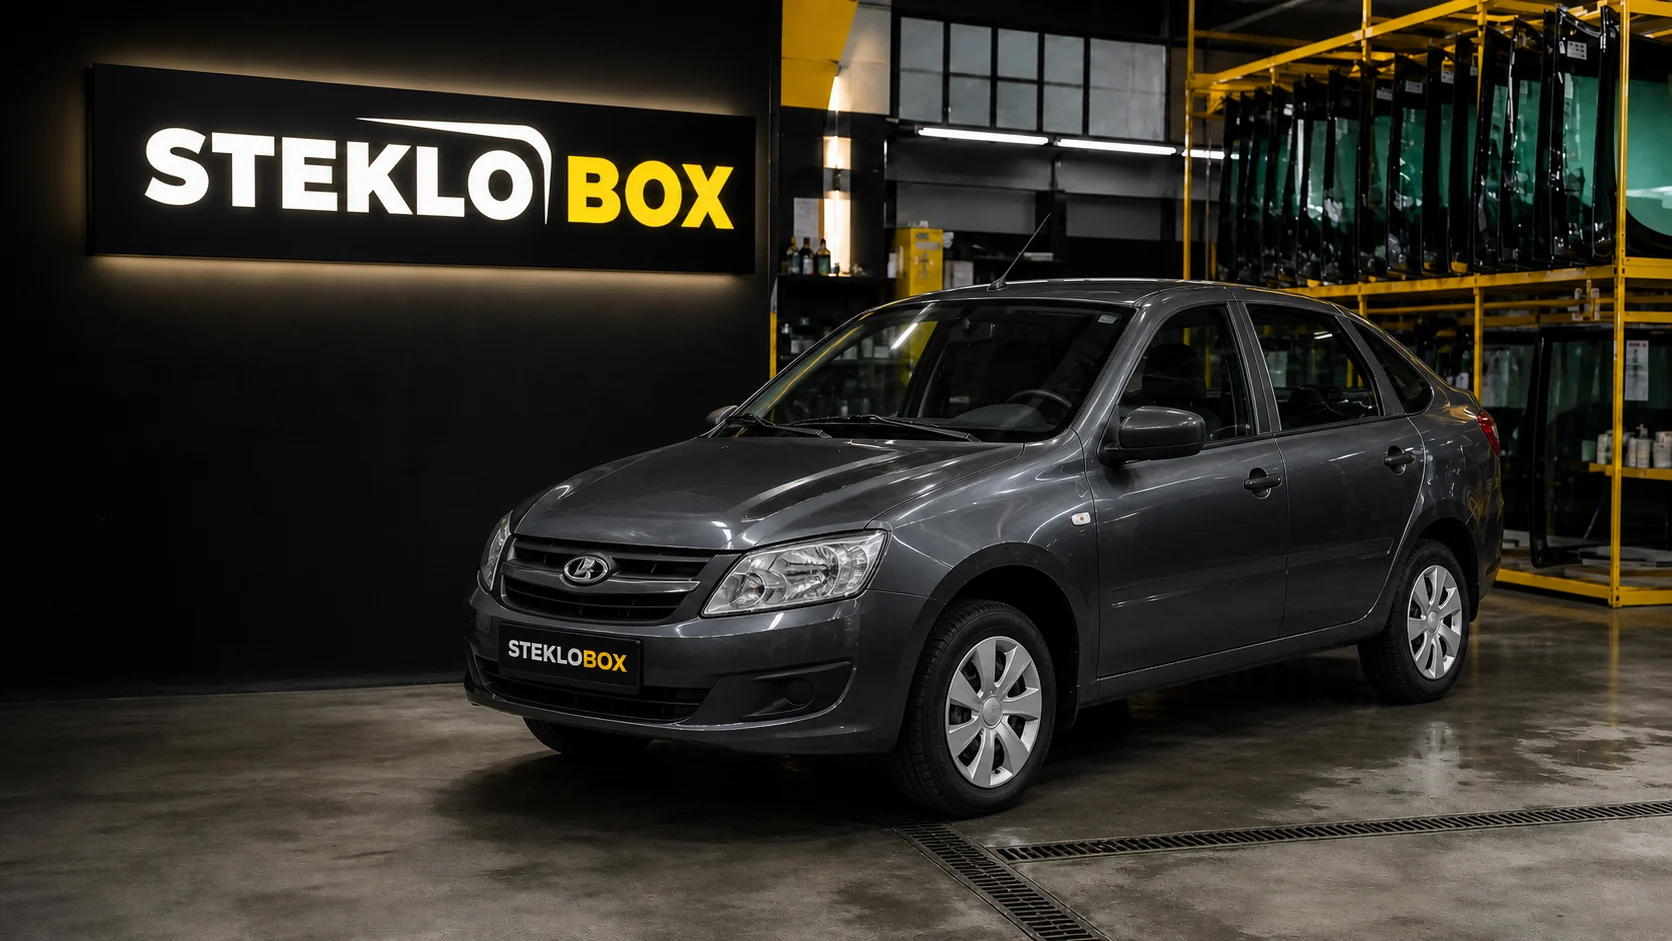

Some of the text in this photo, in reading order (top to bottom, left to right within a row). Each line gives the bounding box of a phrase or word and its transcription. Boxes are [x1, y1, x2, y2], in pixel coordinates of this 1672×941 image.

[144, 126, 735, 230] STEKLO BOX
[508, 639, 628, 673] STEKLOBOX
